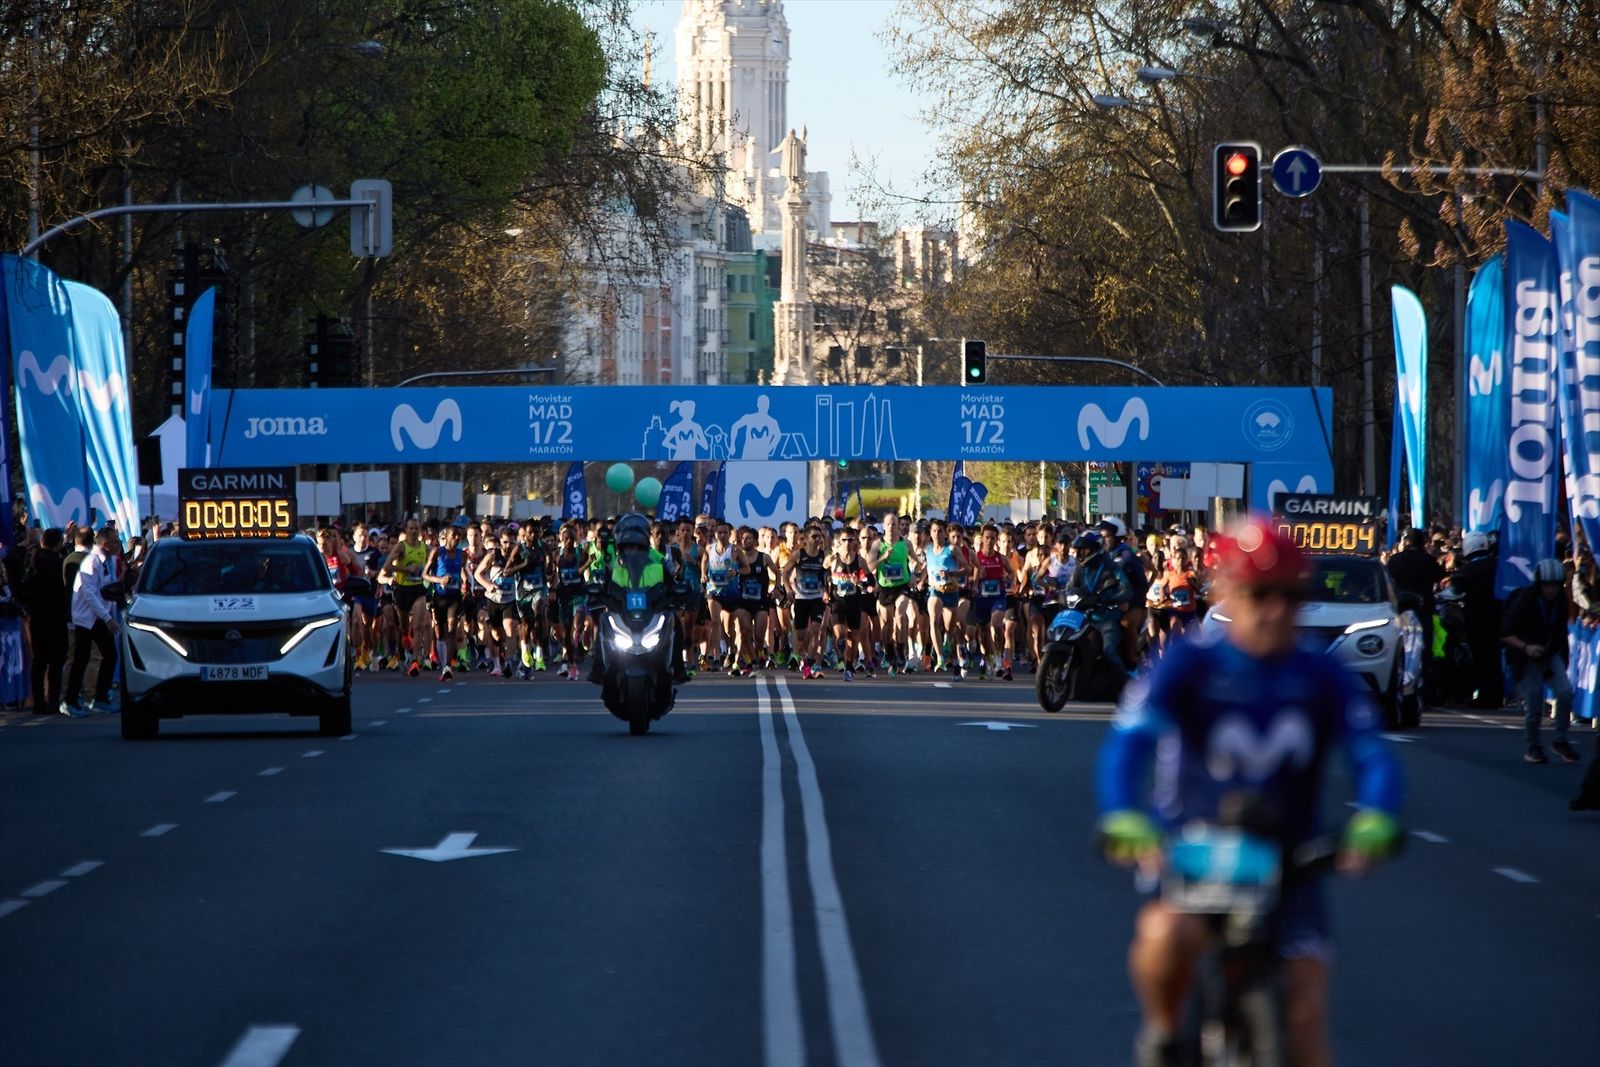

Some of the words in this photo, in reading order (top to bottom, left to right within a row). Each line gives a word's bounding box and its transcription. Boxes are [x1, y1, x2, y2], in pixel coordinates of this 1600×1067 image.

[529, 394, 572, 403] Movistar
[961, 394, 1004, 403] Movistar
[529, 404, 573, 420] MAD
[961, 404, 1005, 419] MAD
[529, 421, 573, 444] 1/2
[961, 420, 1005, 444] 1/2
[529, 444, 573, 454] MARATÓN
[961, 444, 1005, 454] MARATÓN
[191, 473, 284, 490] GARMIN
[186, 500, 290, 529] 00:00:05
[1285, 499, 1370, 516] GARMIN
[631, 597, 643, 606] 11
[209, 667, 238, 679] 4878
[242, 666, 265, 678] MDF
